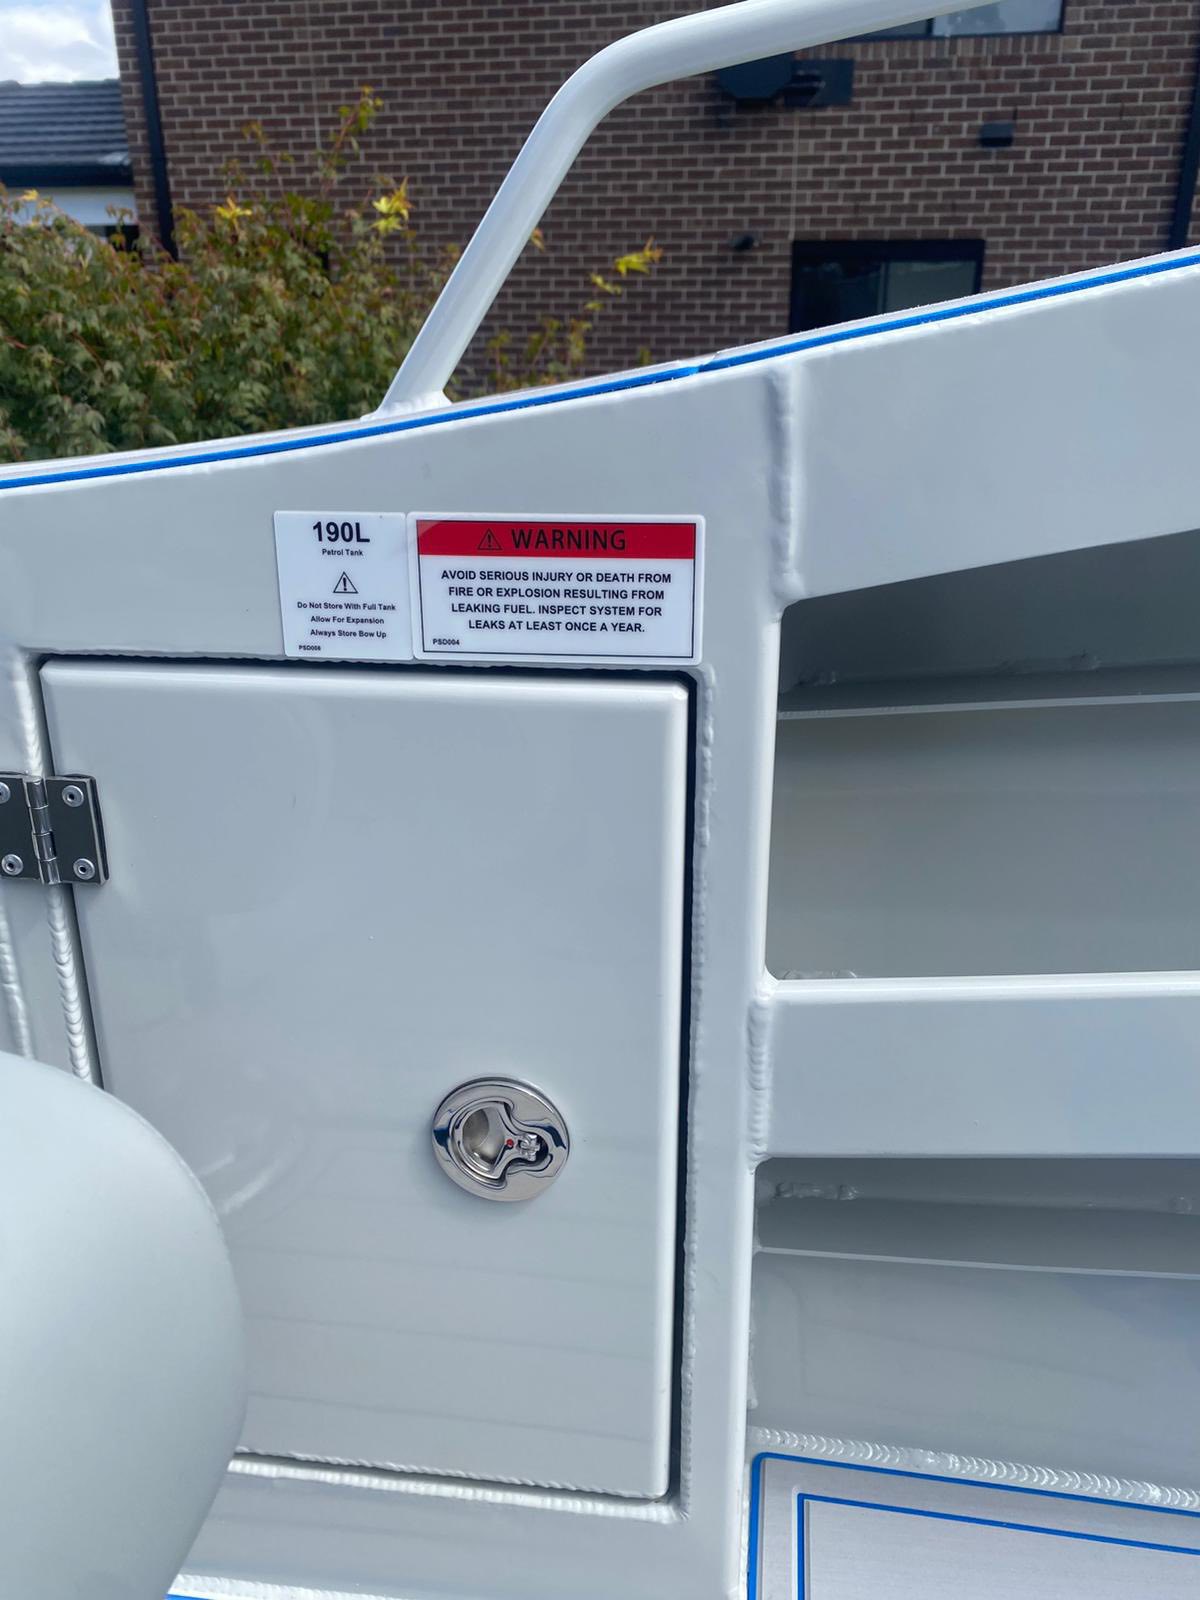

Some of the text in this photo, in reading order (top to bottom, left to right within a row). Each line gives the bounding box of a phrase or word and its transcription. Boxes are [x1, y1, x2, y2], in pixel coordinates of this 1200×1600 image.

[313, 522, 370, 543] 190L
[511, 529, 626, 550] WARNING
[441, 570, 672, 583] AVOID SERIOUS INJURY OR DEATH FROM
[449, 587, 665, 600] FIRE OR EXPLOSION RESULTING FROM
[451, 603, 662, 616] LEAKING FUEL. INSPECT SYSTEM FOR
[346, 617, 384, 625] Expansion
[468, 620, 645, 632] LEAKS AT LEAST ONCE A YEAR.
